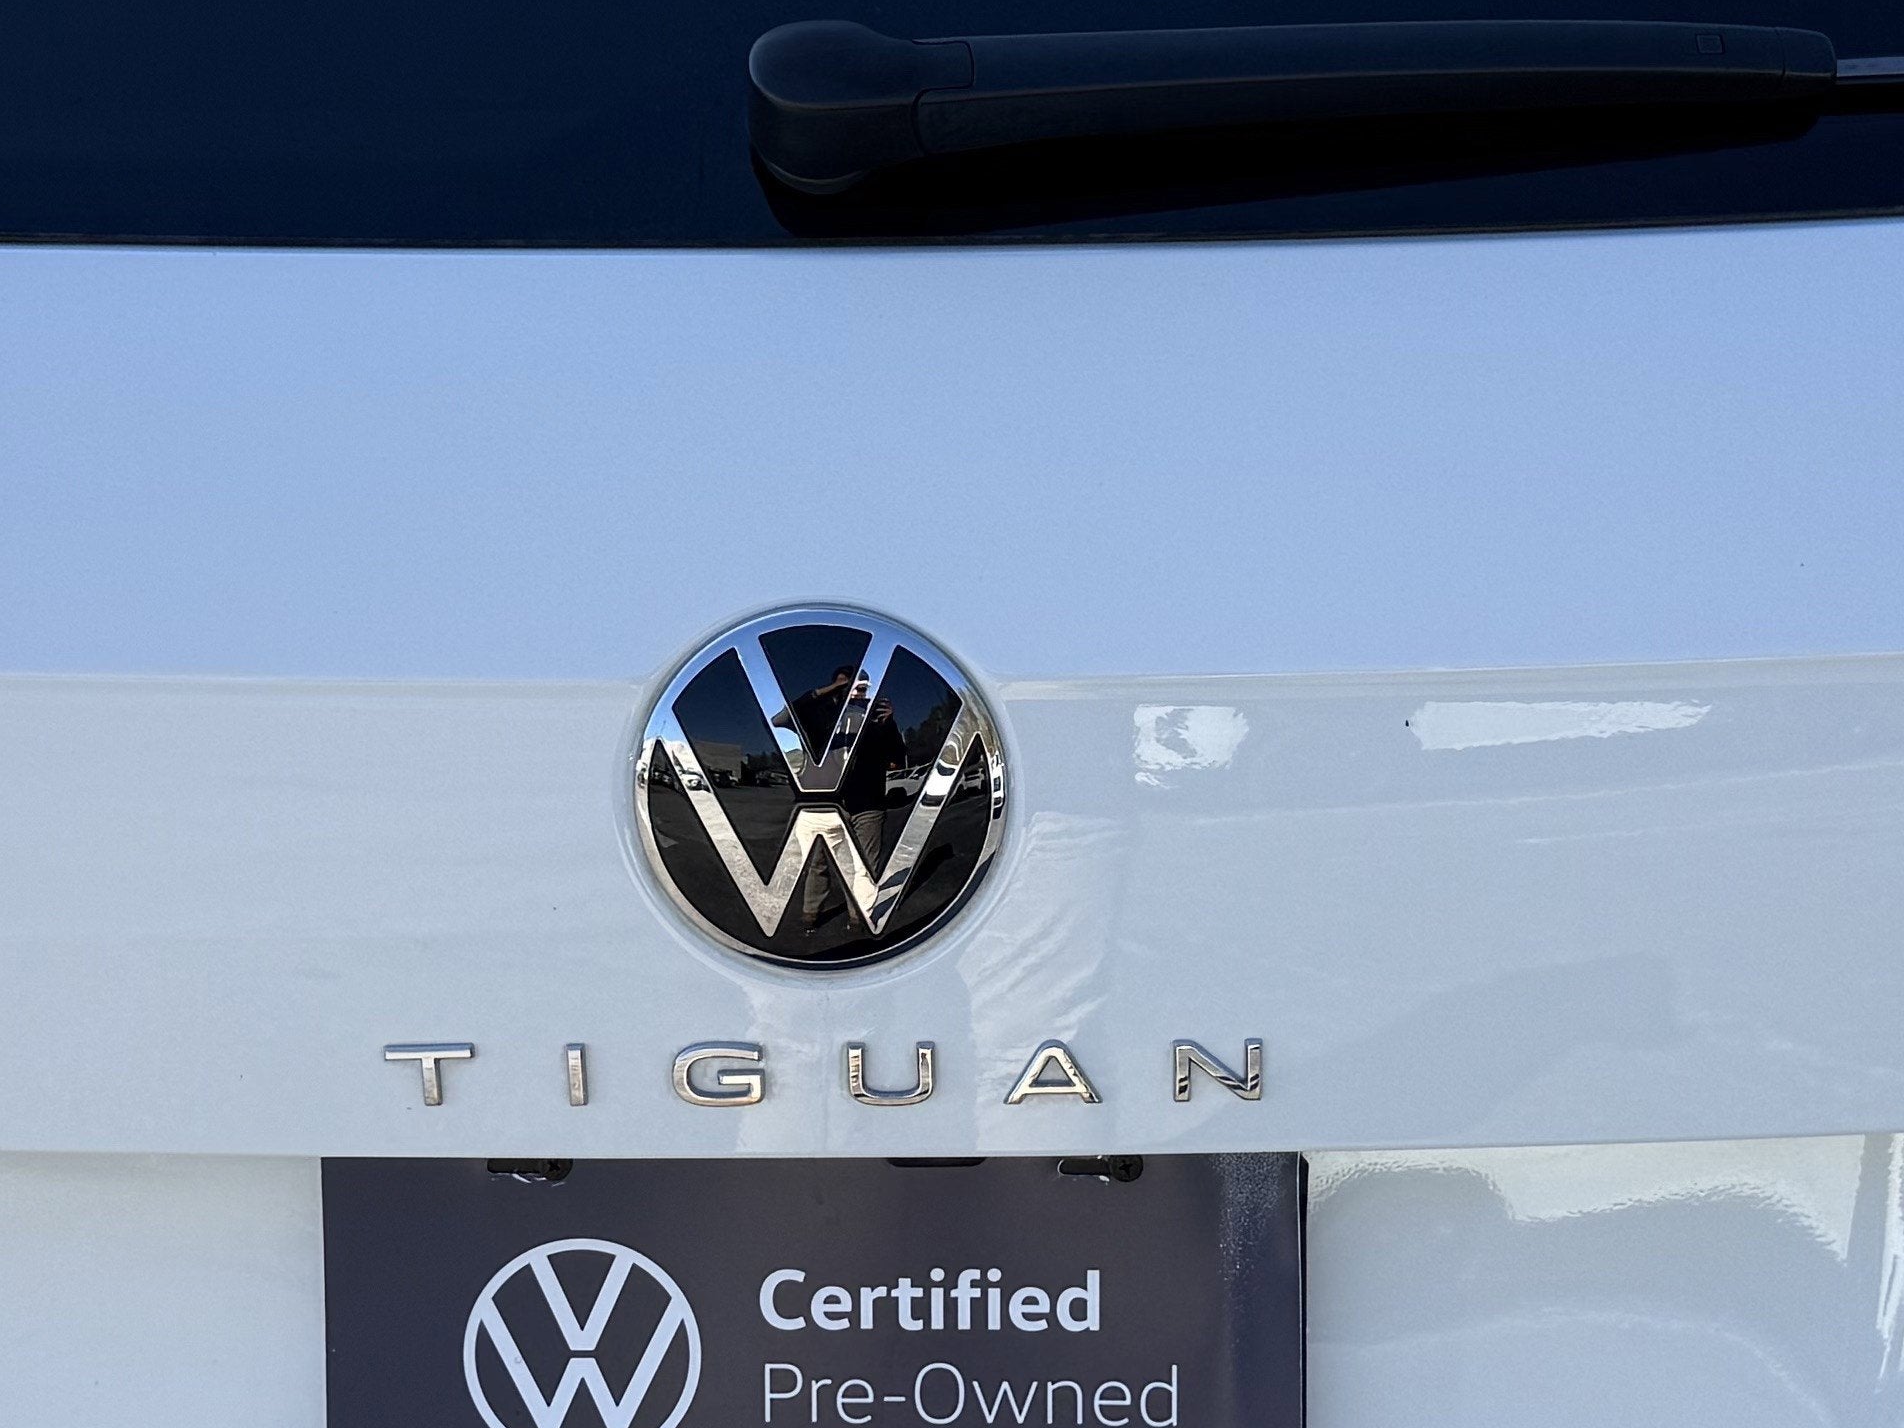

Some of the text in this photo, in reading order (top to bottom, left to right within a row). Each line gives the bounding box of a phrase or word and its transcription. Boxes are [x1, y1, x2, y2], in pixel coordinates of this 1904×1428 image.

[382, 1036, 1264, 1109] TIGUAN
[758, 1267, 1100, 1332] Certified
[763, 1361, 1179, 1428] Pre-Owned
